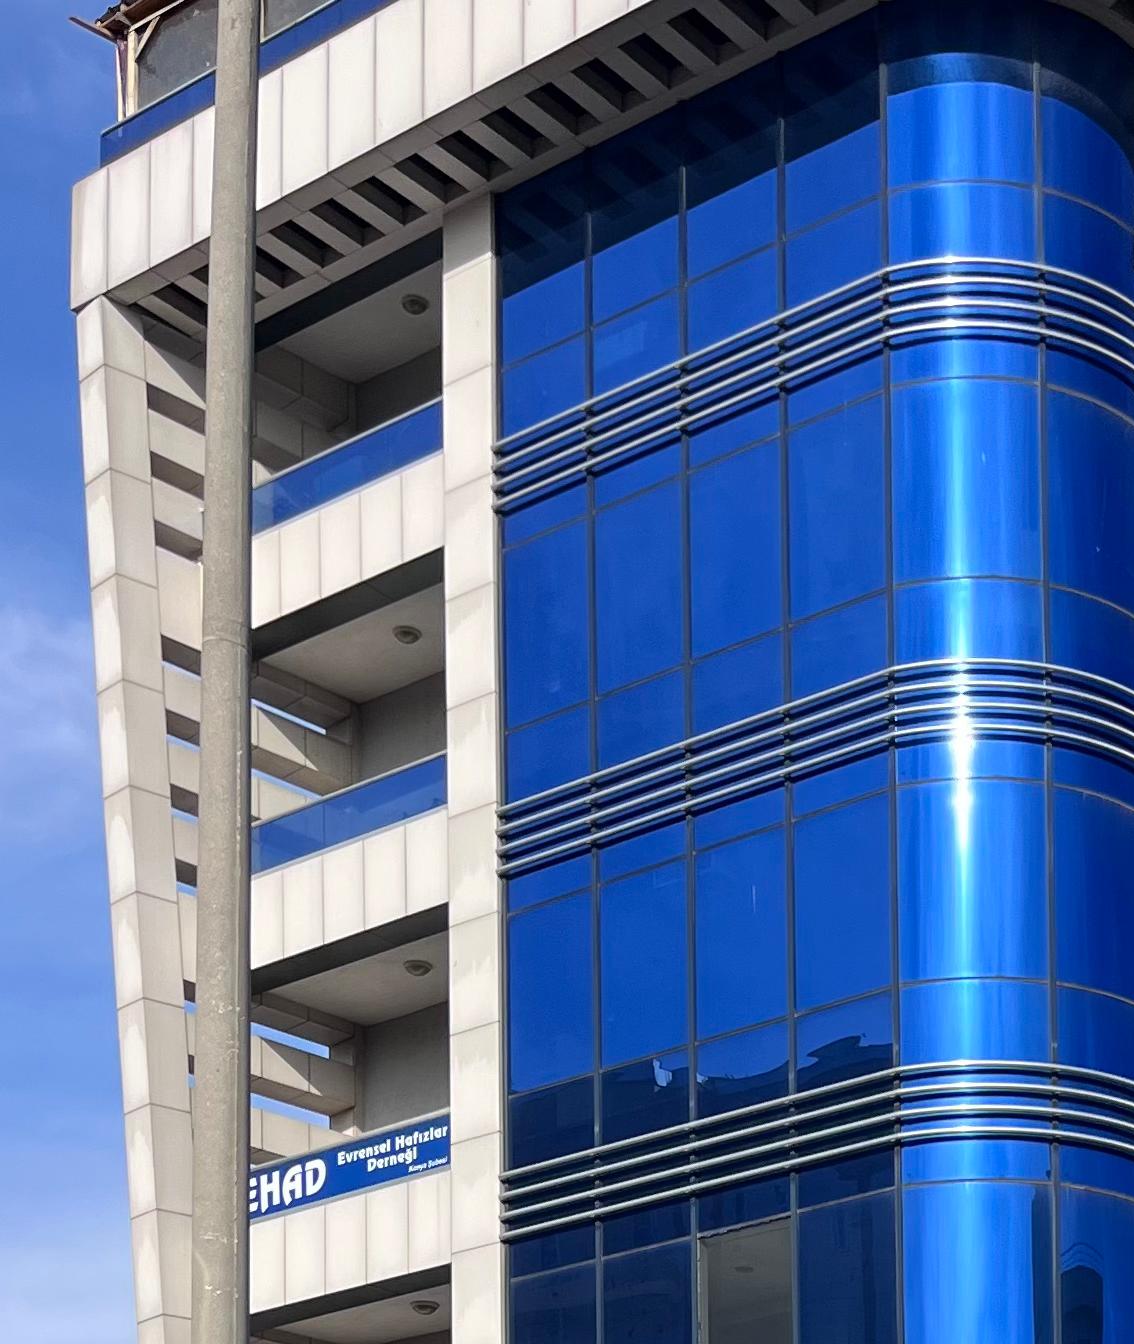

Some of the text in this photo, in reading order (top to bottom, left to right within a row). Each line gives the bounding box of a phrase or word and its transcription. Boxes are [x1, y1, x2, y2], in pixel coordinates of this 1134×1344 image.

[337, 1125, 449, 1166] Evrensel Hafızlar
[367, 1147, 418, 1172] Derneği
